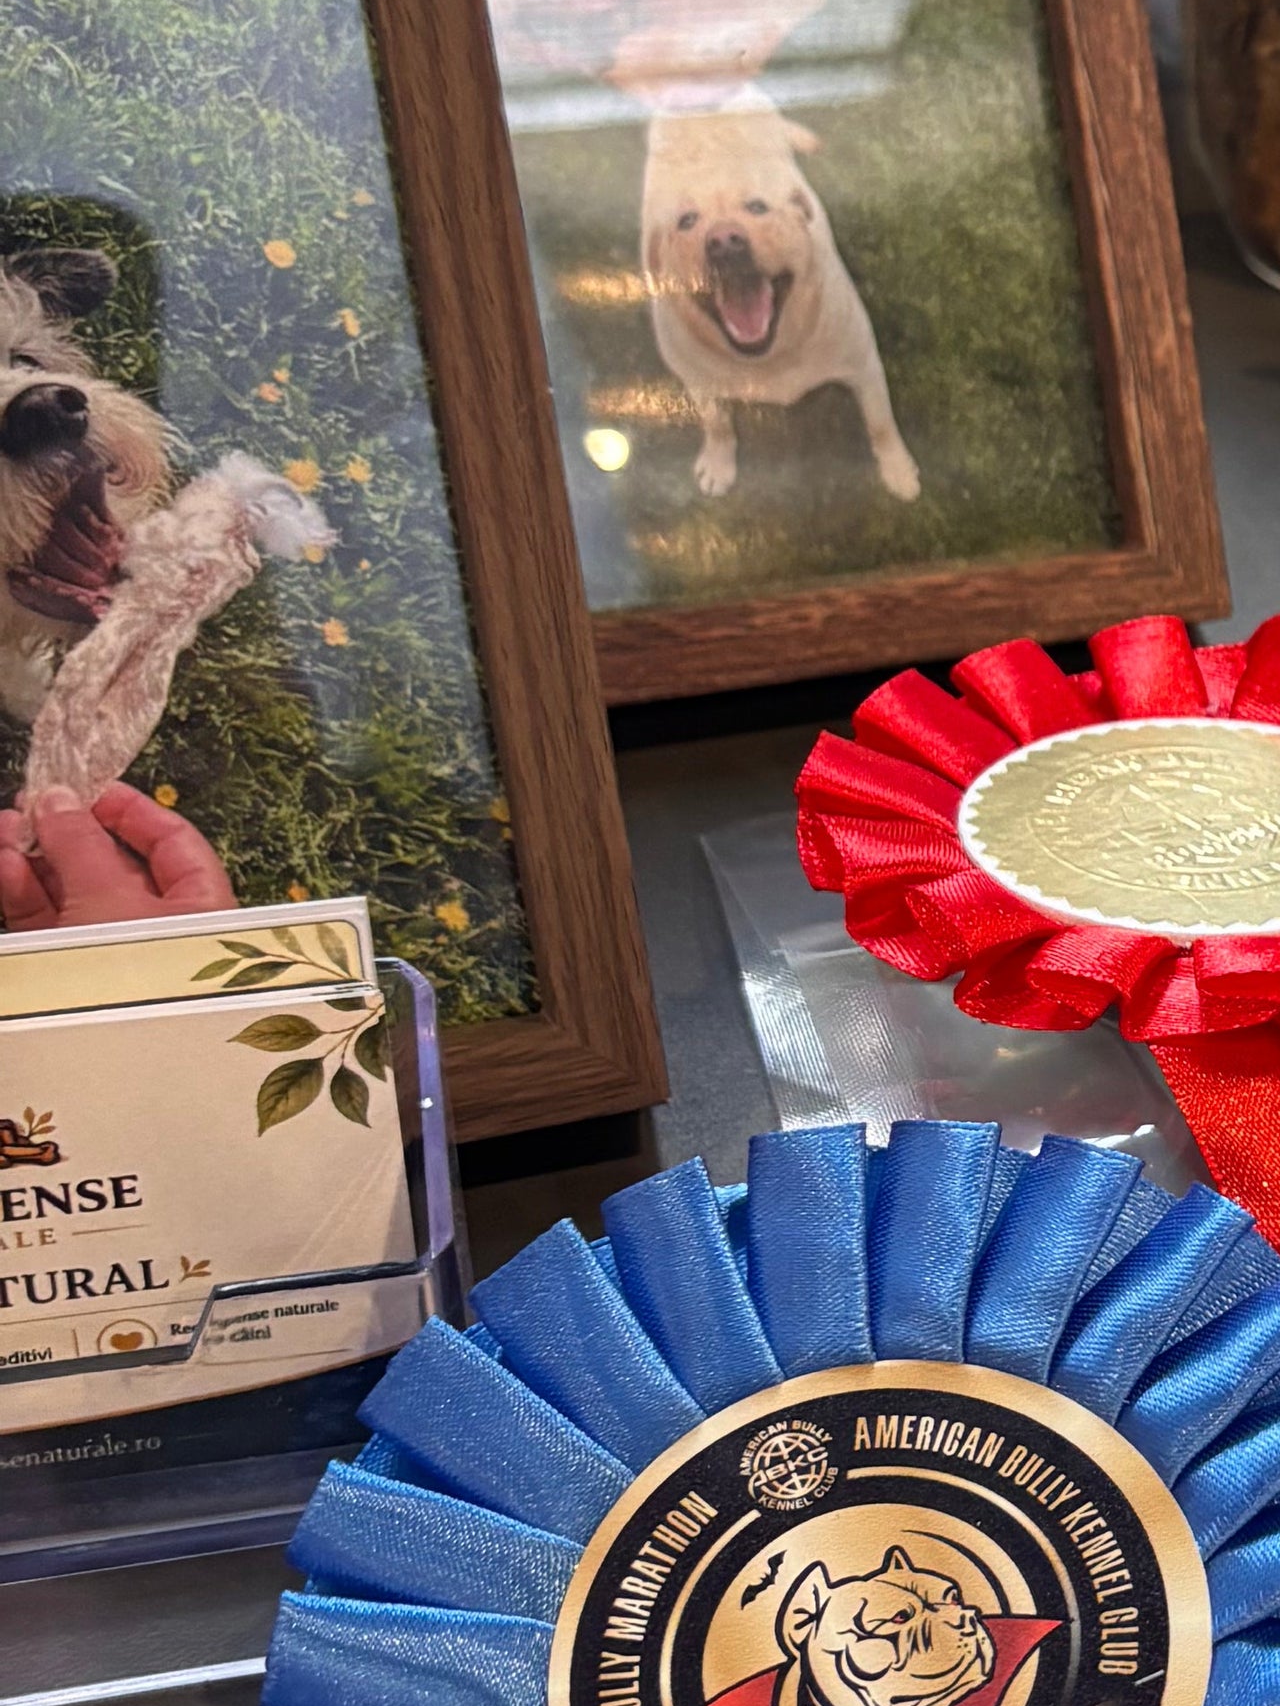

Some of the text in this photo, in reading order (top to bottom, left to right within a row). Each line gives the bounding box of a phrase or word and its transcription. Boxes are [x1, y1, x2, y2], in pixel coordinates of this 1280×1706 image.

[273, 1299, 340, 1321] naturale
[739, 1419, 833, 1476] AMERICAN BULLY
[757, 1466, 839, 1511] KENNEL CLUB
[603, 1490, 720, 1642] MARATHON
[853, 1414, 1140, 1676] AMERICAN BULLY KENNEL CLUB
